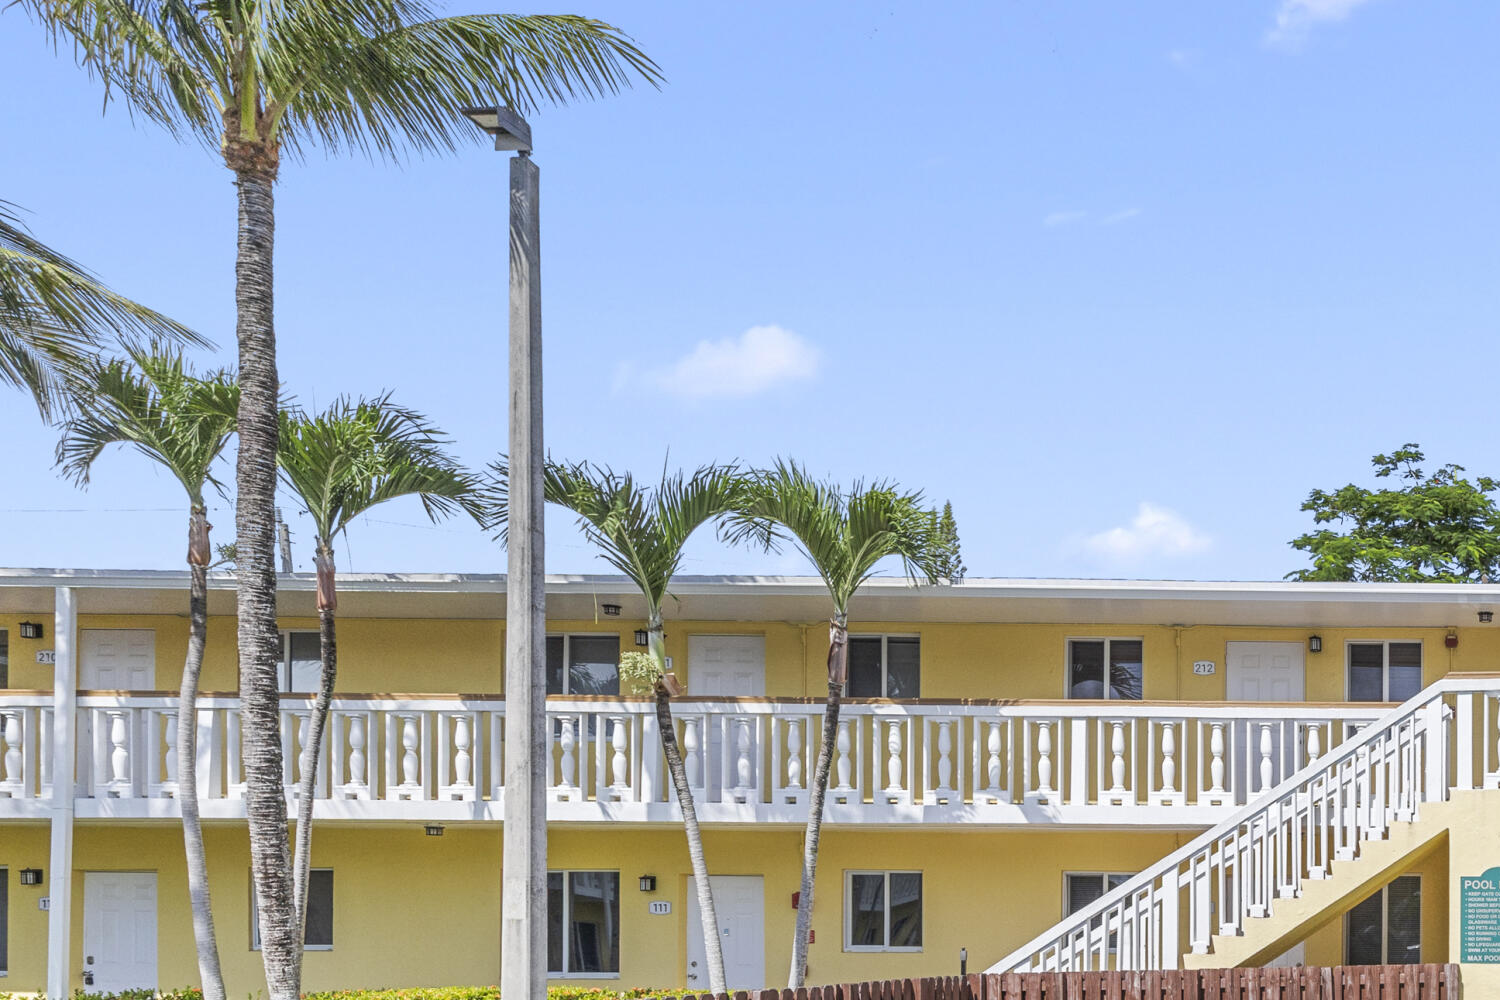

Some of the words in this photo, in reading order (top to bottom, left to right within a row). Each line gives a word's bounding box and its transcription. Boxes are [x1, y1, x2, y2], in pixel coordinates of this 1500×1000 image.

[1195, 664, 1212, 672] 212
[1464, 880, 1496, 890] POOL
[653, 904, 667, 912] 111
